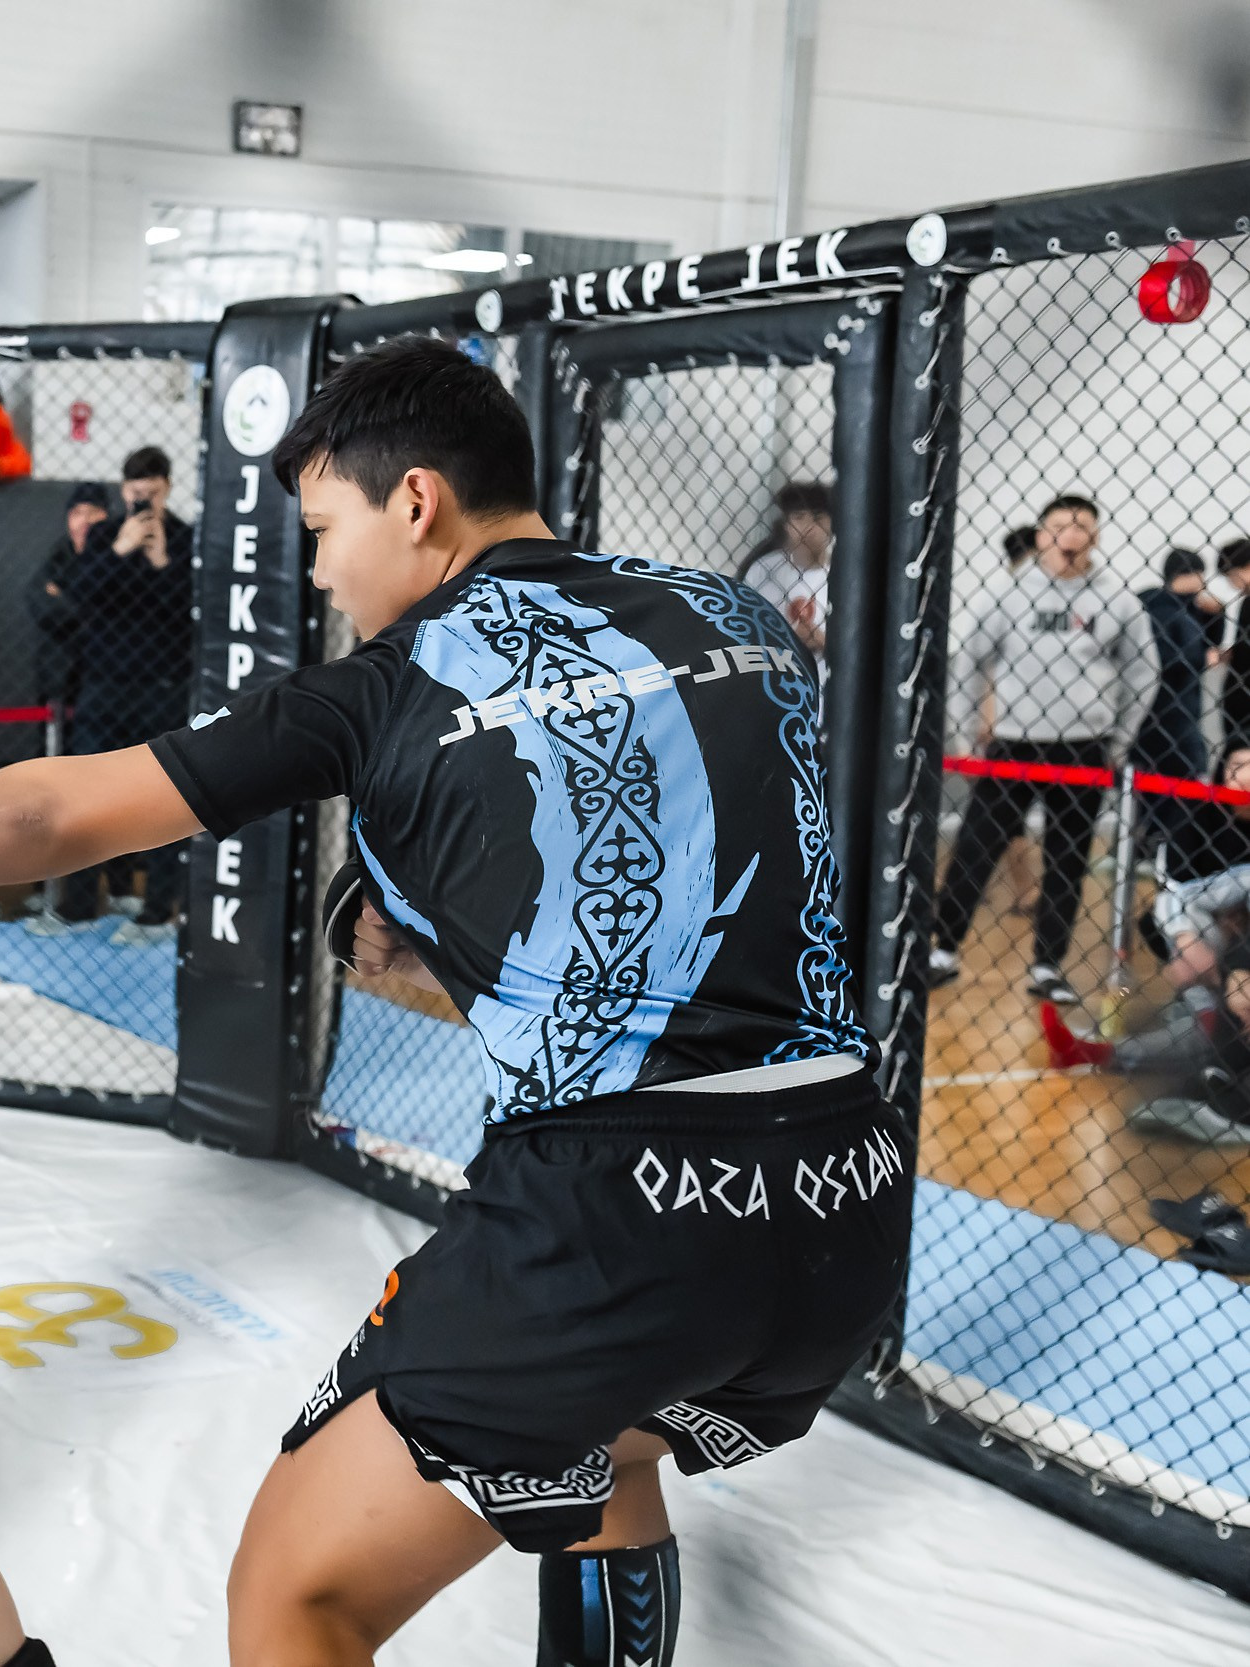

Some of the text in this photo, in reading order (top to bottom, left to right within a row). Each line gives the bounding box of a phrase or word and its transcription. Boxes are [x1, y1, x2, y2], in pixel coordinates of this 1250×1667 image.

[548, 228, 849, 322] JEKPE JEK
[210, 465, 260, 945] JEKP EK
[437, 644, 804, 747] JEKPE-JEK
